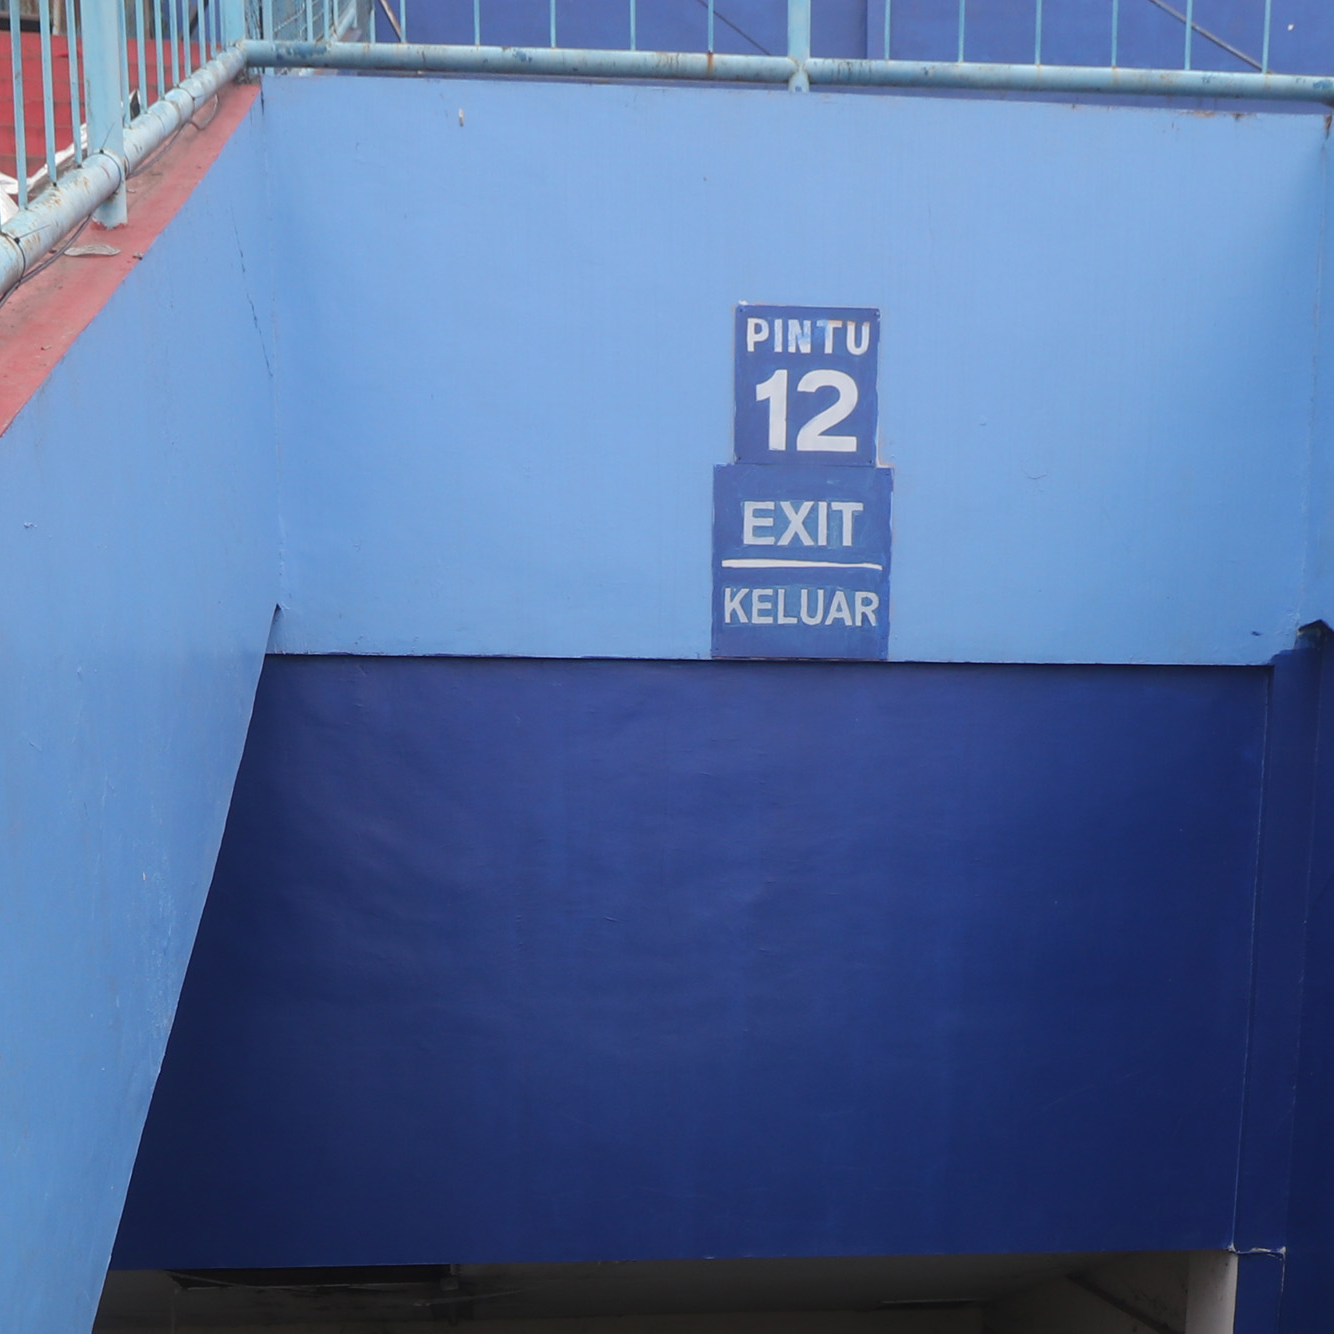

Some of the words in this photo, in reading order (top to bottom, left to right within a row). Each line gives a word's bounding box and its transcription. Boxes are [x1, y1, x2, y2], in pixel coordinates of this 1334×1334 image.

[746, 317, 871, 356] PINTU
[755, 368, 859, 453] 12
[742, 500, 864, 547] EXIT
[723, 587, 881, 627] KELUAR
